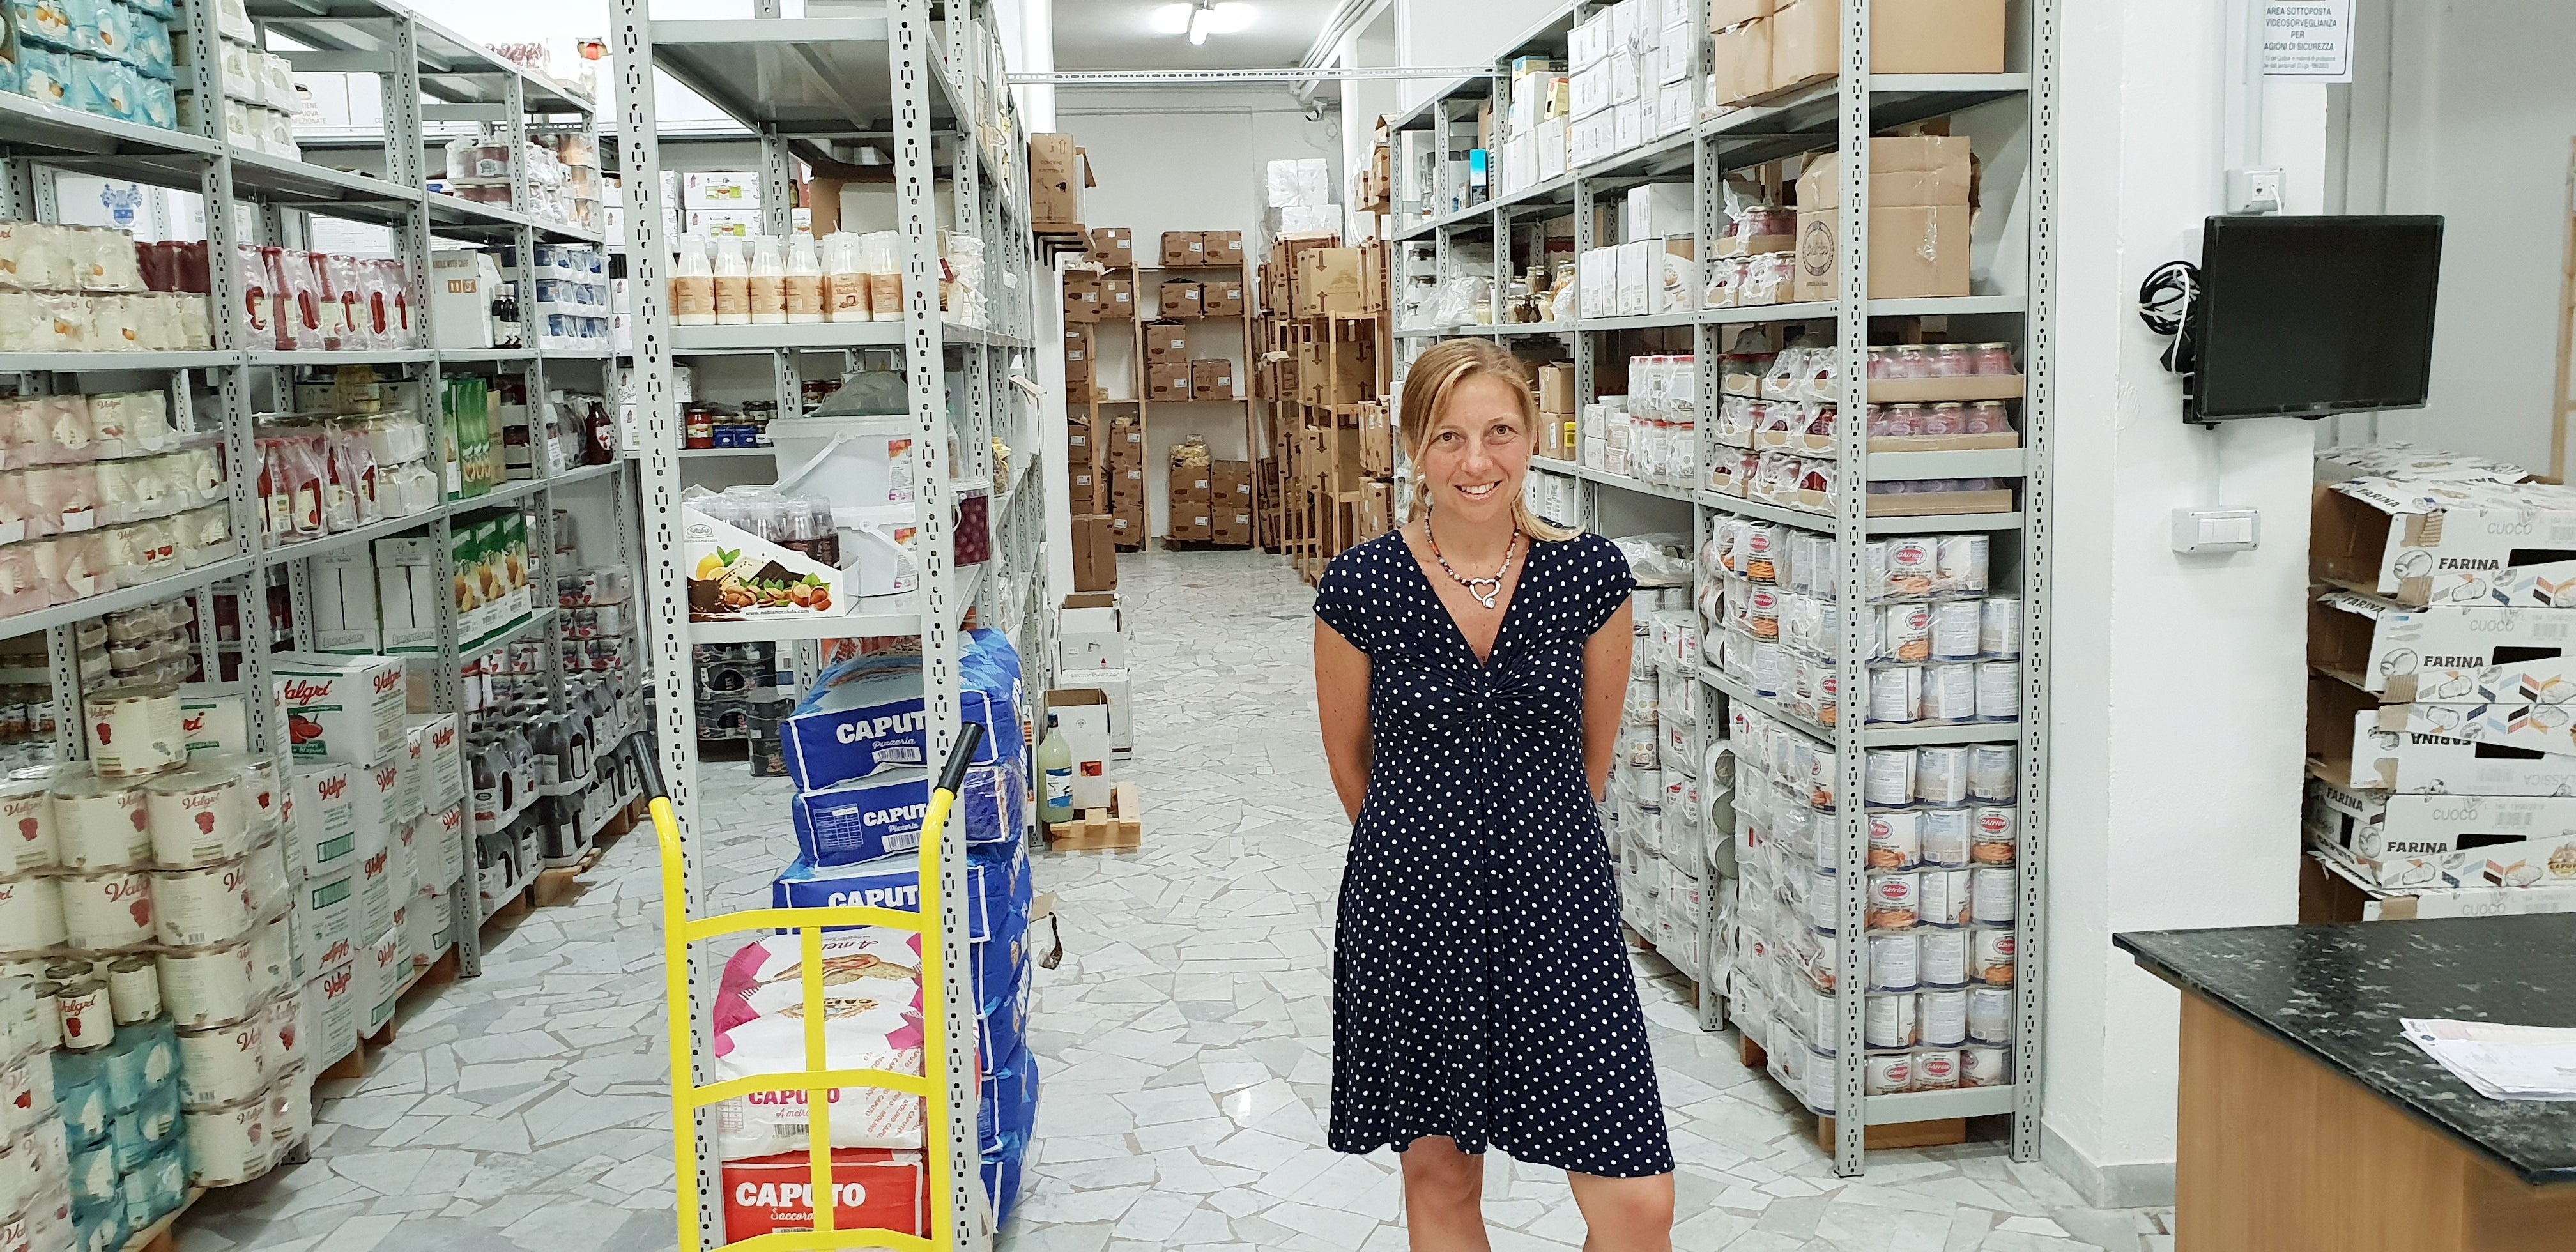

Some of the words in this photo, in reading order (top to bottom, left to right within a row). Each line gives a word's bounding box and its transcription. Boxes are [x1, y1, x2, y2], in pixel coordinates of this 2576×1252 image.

[2267, 7, 2285, 15] AREA
[2287, 7, 2331, 15] SOTTOPOSTA
[2266, 19, 2336, 27] VIDEOSORVEGLIANZA
[2264, 42, 2287, 50] AGIONI
[2297, 43, 2334, 51] SICUREZZA
[2356, 488, 2402, 508] FARINA
[2487, 522, 2533, 535] CUOCO
[2438, 558, 2499, 570] FARINA
[2470, 620, 2515, 632] CUOCO
[2423, 655, 2484, 668] FARINA
[284, 679, 332, 706] algri
[836, 710, 926, 744] CAPUT
[872, 737, 916, 750] Pizzeria
[2524, 775, 2576, 786] LASSICA
[2326, 786, 2363, 813] FARINA
[863, 802, 927, 827] CAPUT
[2432, 809, 2478, 821] CUOCO
[888, 821, 919, 833] Pizzeria
[2386, 841, 2448, 853] FARINA
[828, 885, 918, 907] CAPUT
[2462, 903, 2506, 916] CUOCO
[748, 1088, 841, 1105] CAPUO
[865, 1094, 884, 1117] CAPUTO
[890, 1099, 909, 1122] MOLINO
[867, 1110, 887, 1133] MOLINO
[897, 1110, 916, 1134] CAPUTO
